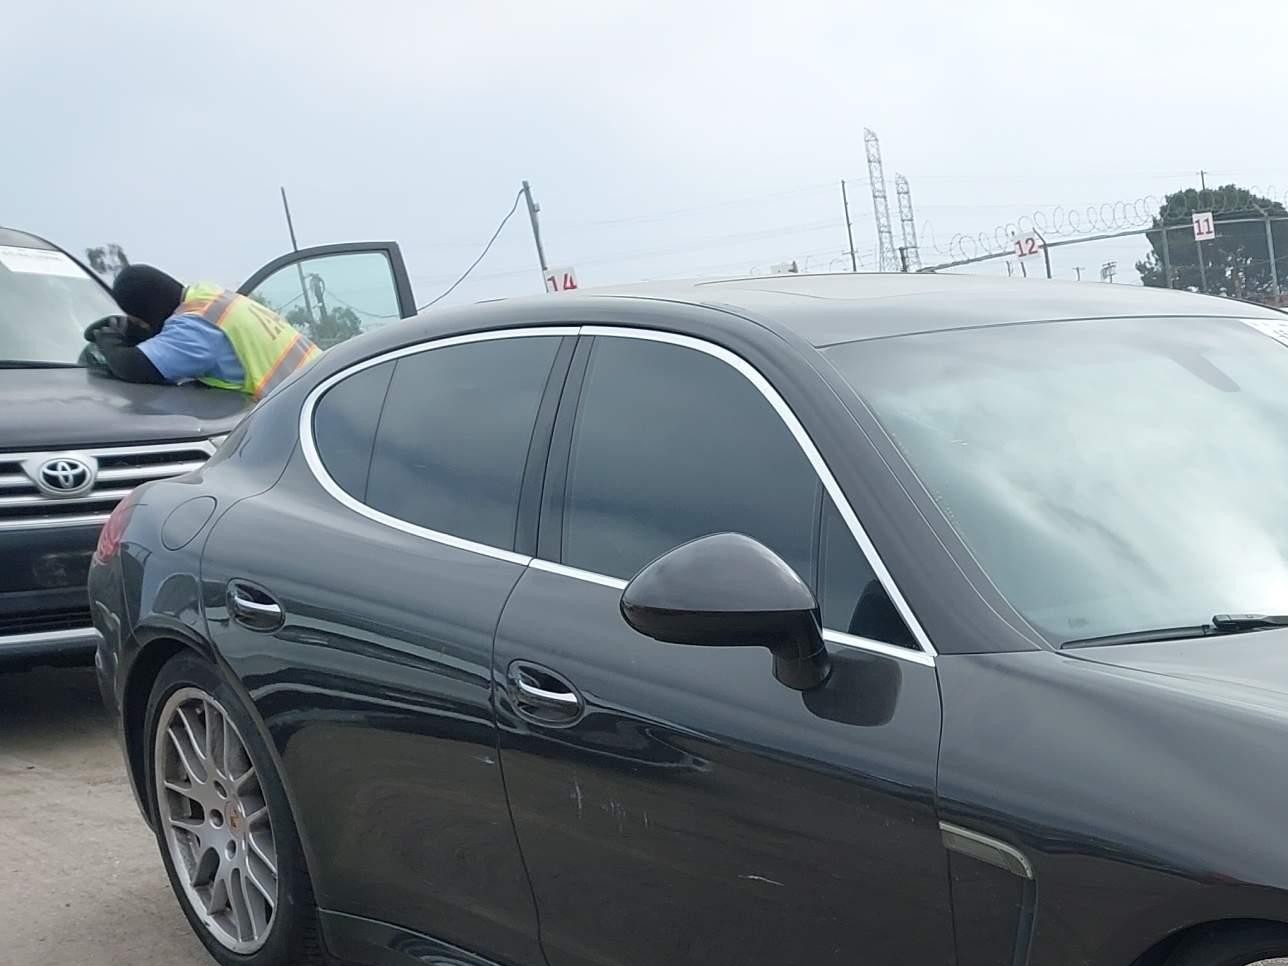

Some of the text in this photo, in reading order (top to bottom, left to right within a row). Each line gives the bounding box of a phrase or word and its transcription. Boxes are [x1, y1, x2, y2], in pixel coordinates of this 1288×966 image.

[1194, 217, 1213, 235] 11
[1015, 237, 1039, 257] 12
[547, 273, 578, 291] 14
